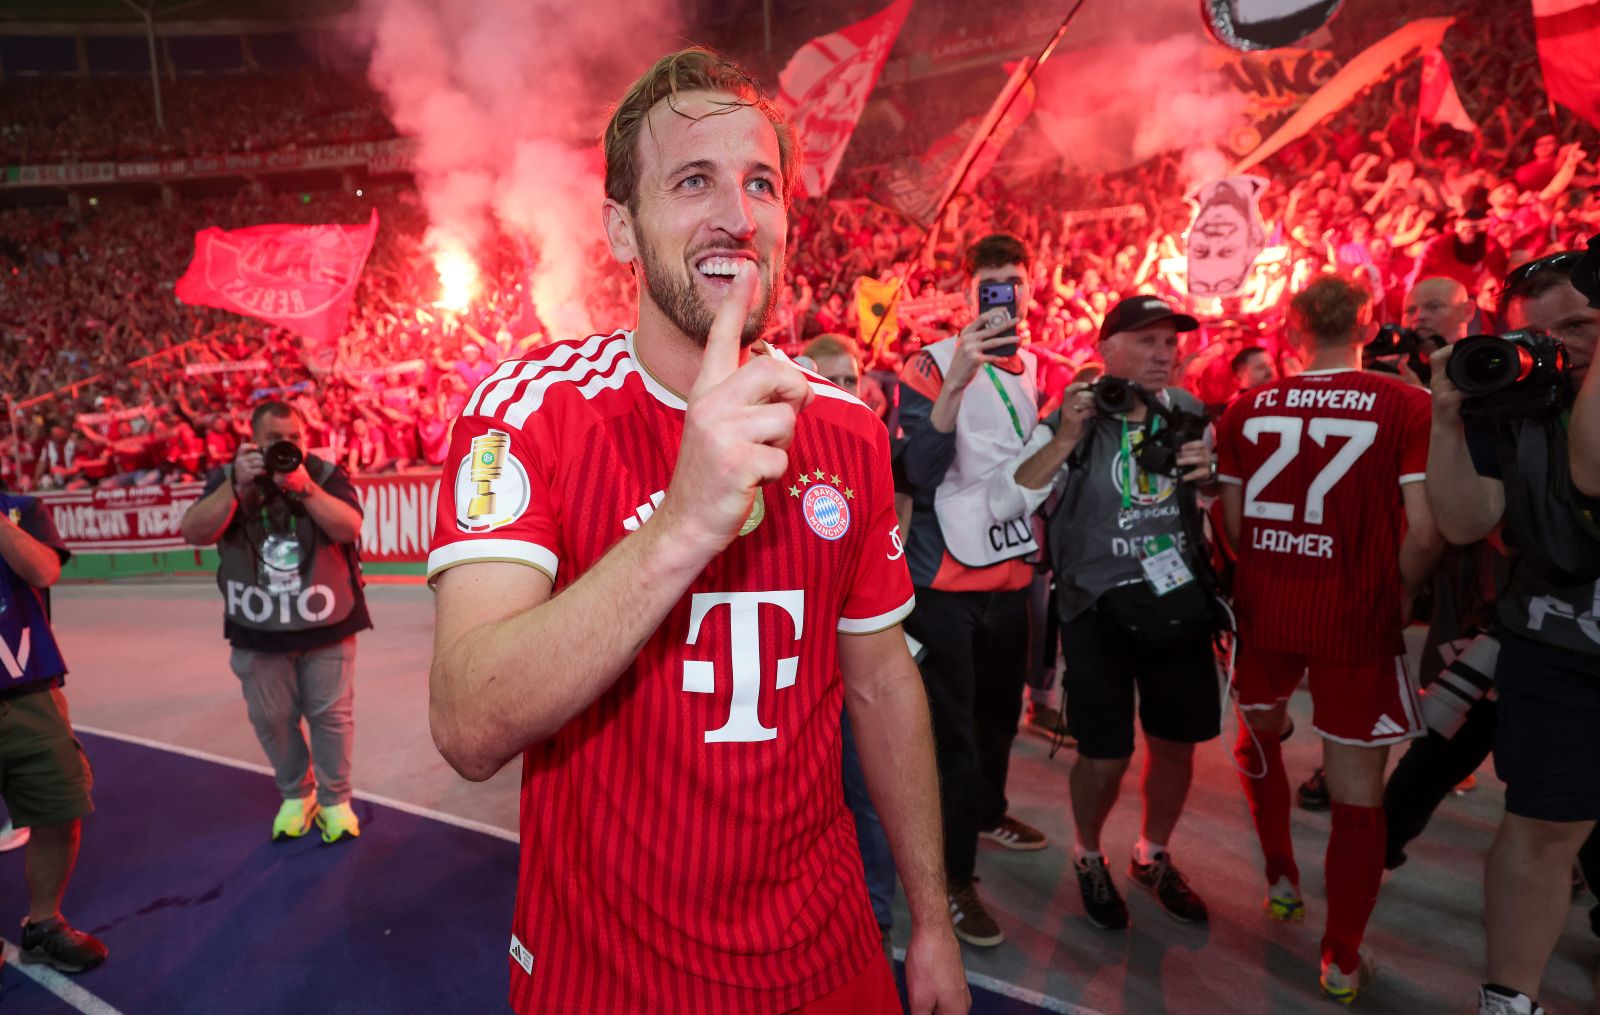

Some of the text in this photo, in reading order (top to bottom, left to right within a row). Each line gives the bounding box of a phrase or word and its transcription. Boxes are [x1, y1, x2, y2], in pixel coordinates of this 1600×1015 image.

[1254, 388, 1377, 411] FC BAYERN
[1242, 415, 1379, 525] 27
[807, 489, 844, 509] FC BAYERN
[1252, 527, 1334, 559] LAIMER
[226, 580, 336, 624] FOTO
[682, 589, 805, 743] T
